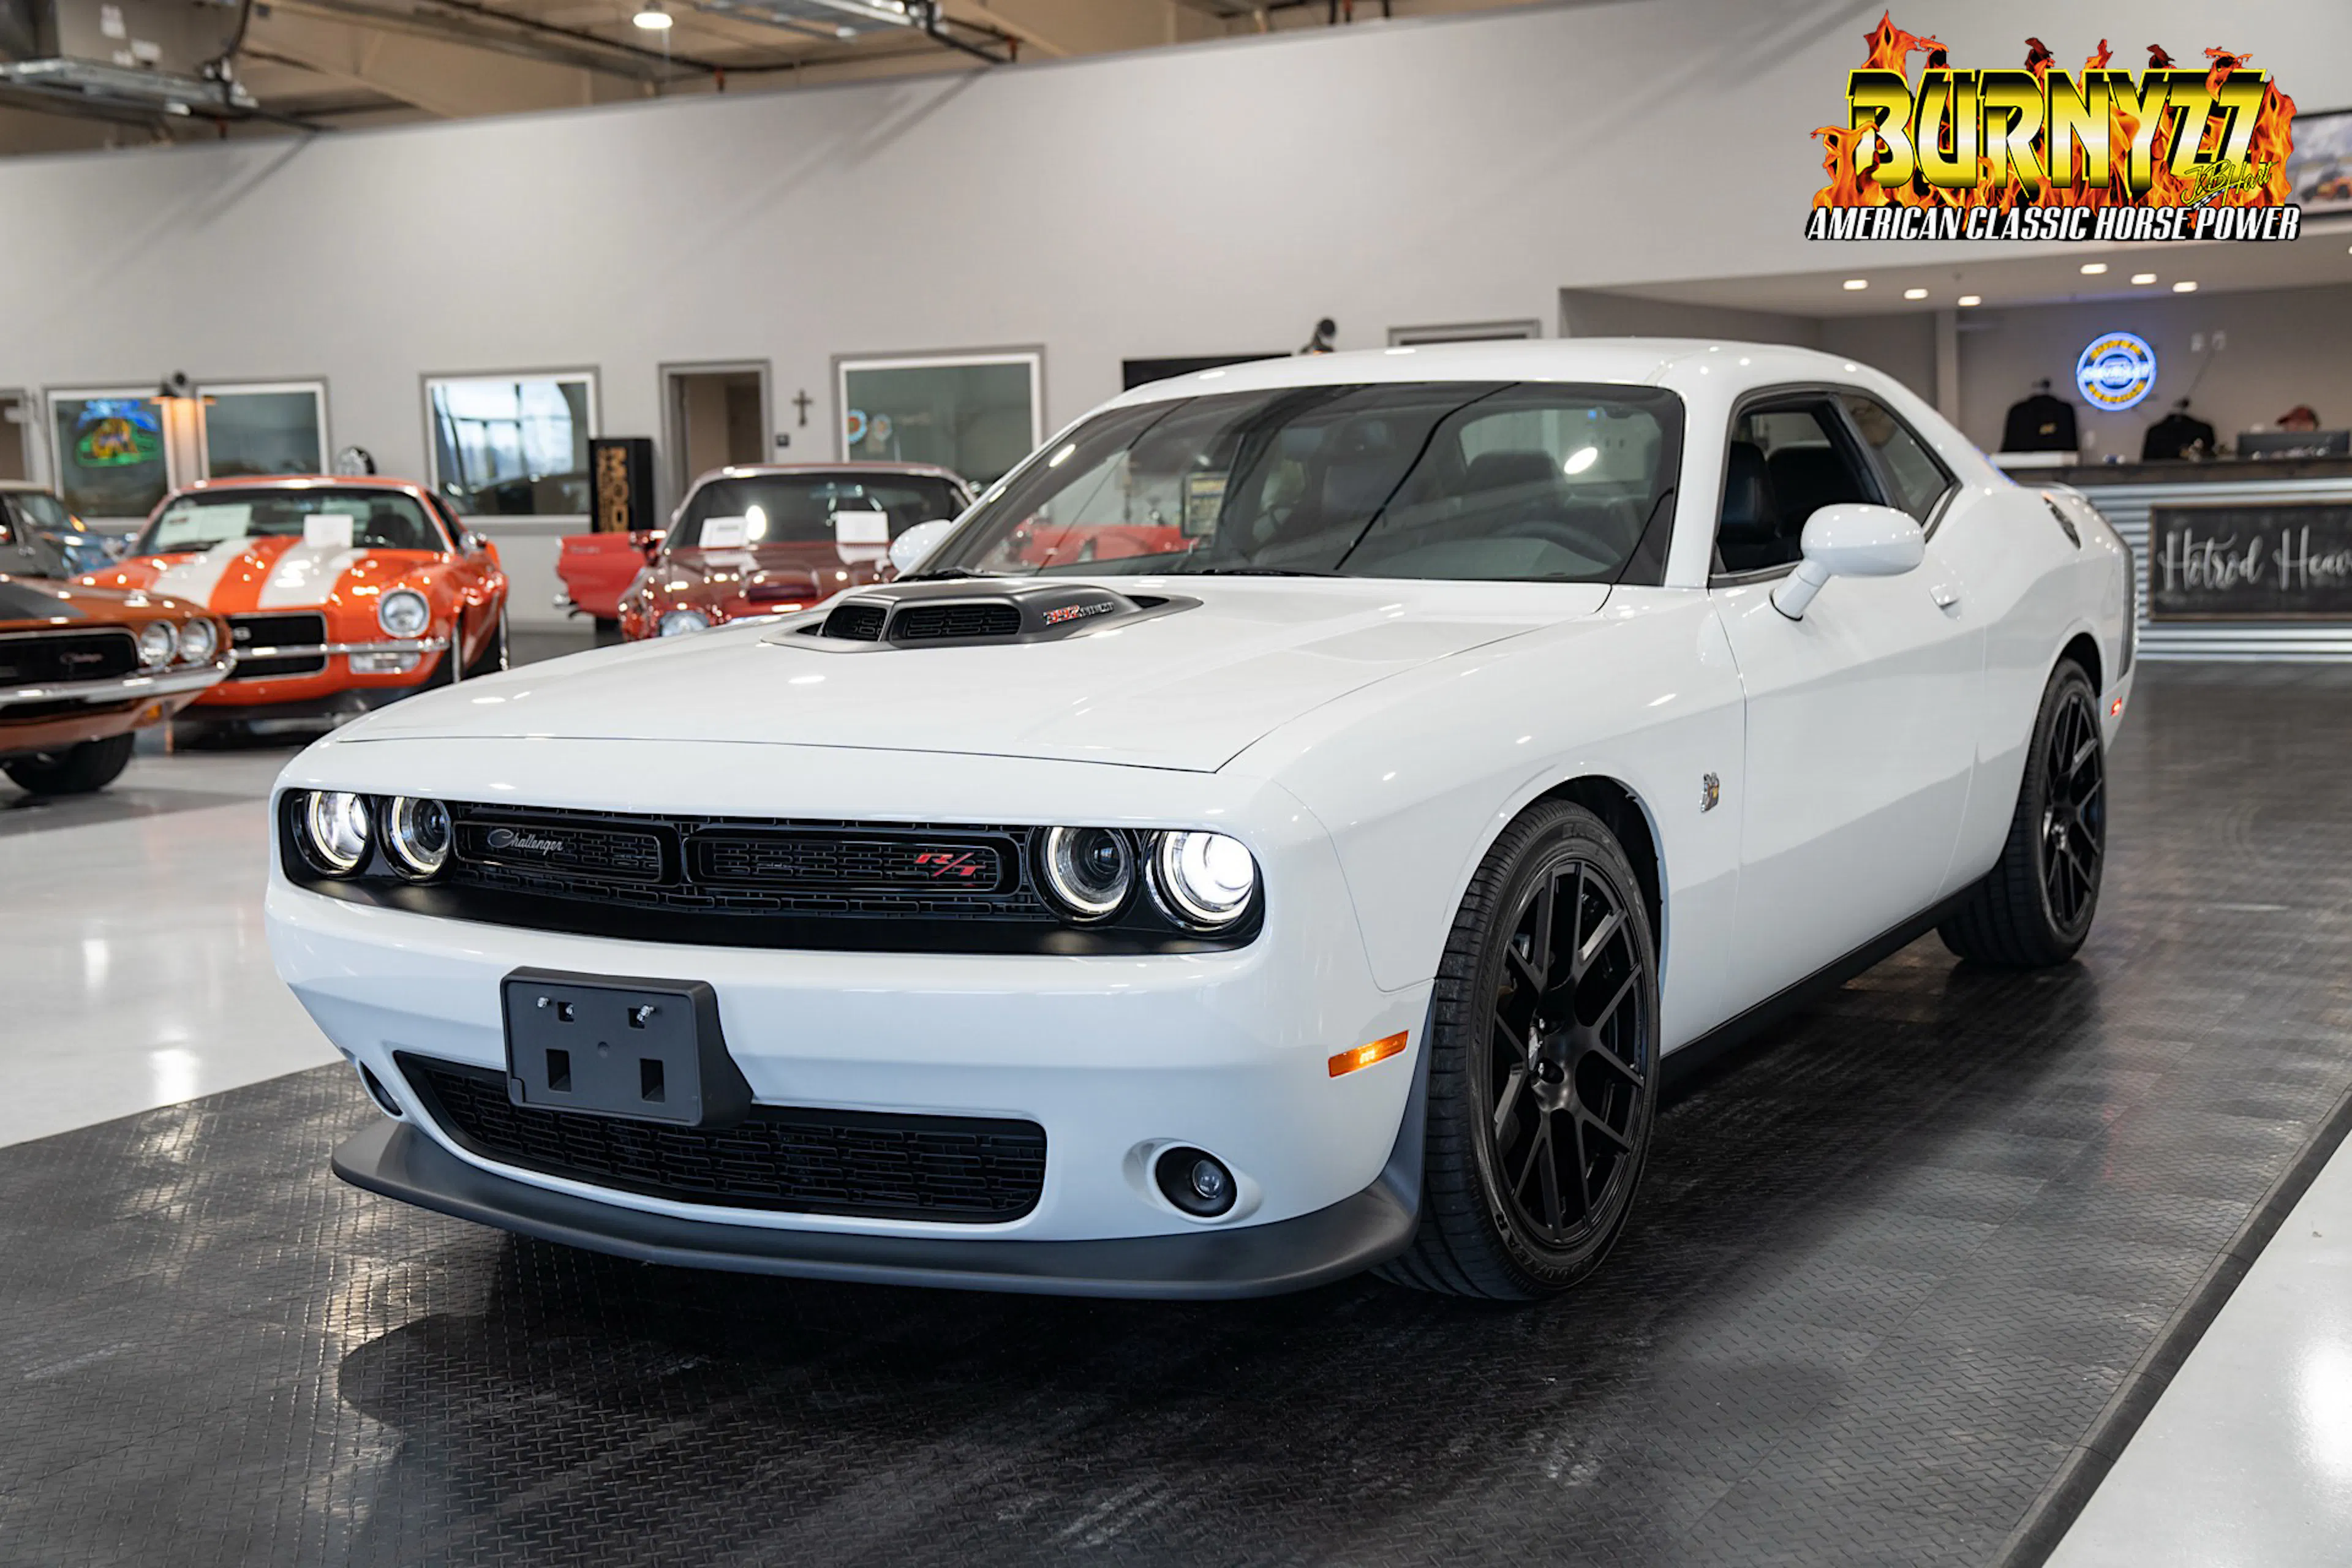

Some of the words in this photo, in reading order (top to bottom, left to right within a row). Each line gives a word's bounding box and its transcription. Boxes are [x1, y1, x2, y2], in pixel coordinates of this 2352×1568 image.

[2157, 527, 2266, 590] Hotrod
[486, 828, 565, 856] Challenger
[913, 851, 987, 877] R/T
